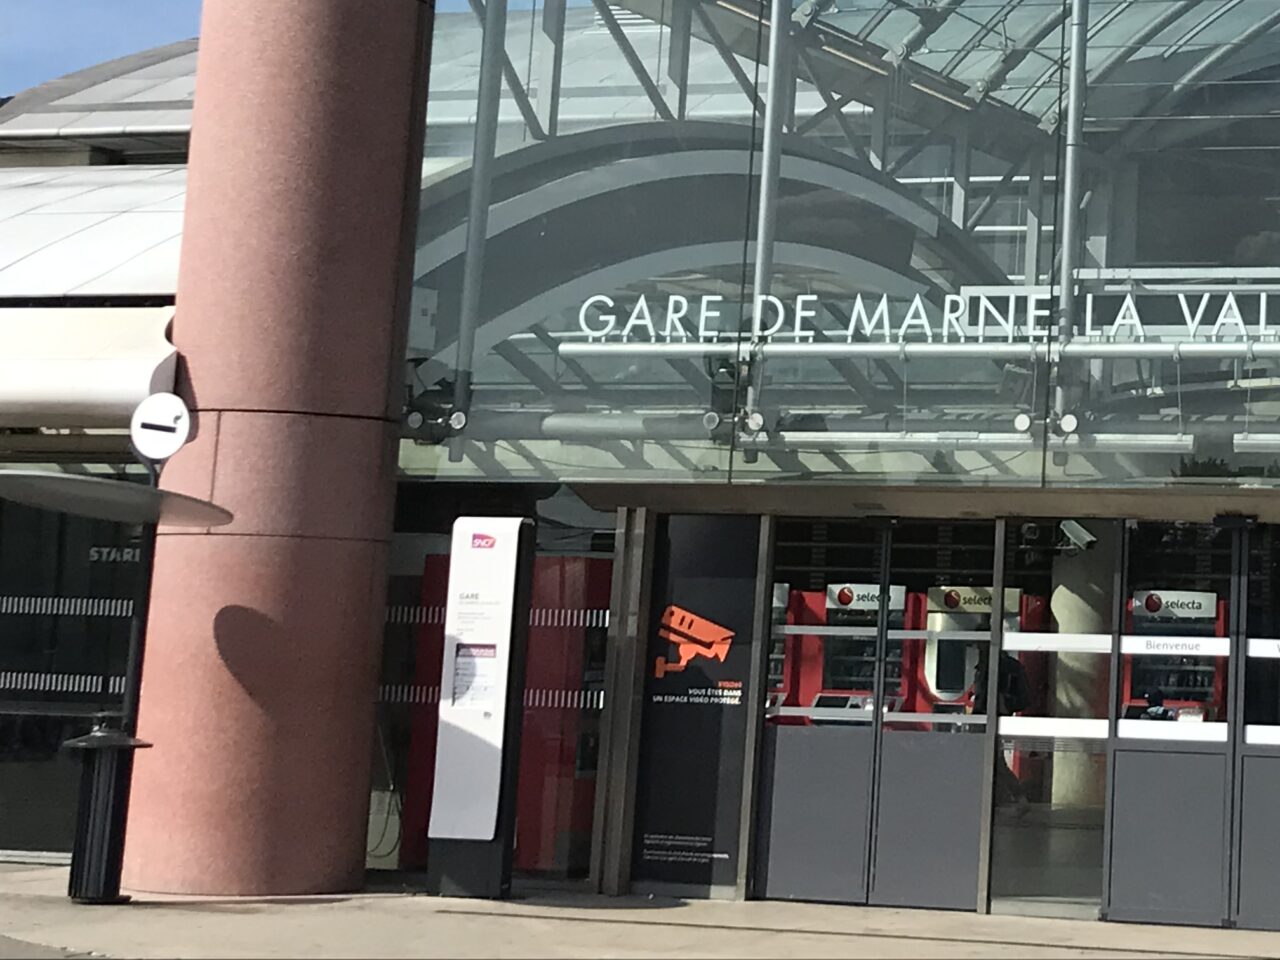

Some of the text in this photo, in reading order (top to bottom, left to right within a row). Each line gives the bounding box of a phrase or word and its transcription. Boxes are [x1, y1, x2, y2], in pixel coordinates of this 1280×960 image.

[579, 294, 722, 337] GARE
[755, 294, 817, 337] DE
[846, 293, 1050, 338] MARNE
[1085, 292, 1144, 337] LA
[1164, 598, 1202, 610] selecta
[1145, 641, 1201, 652] Bienvenue
